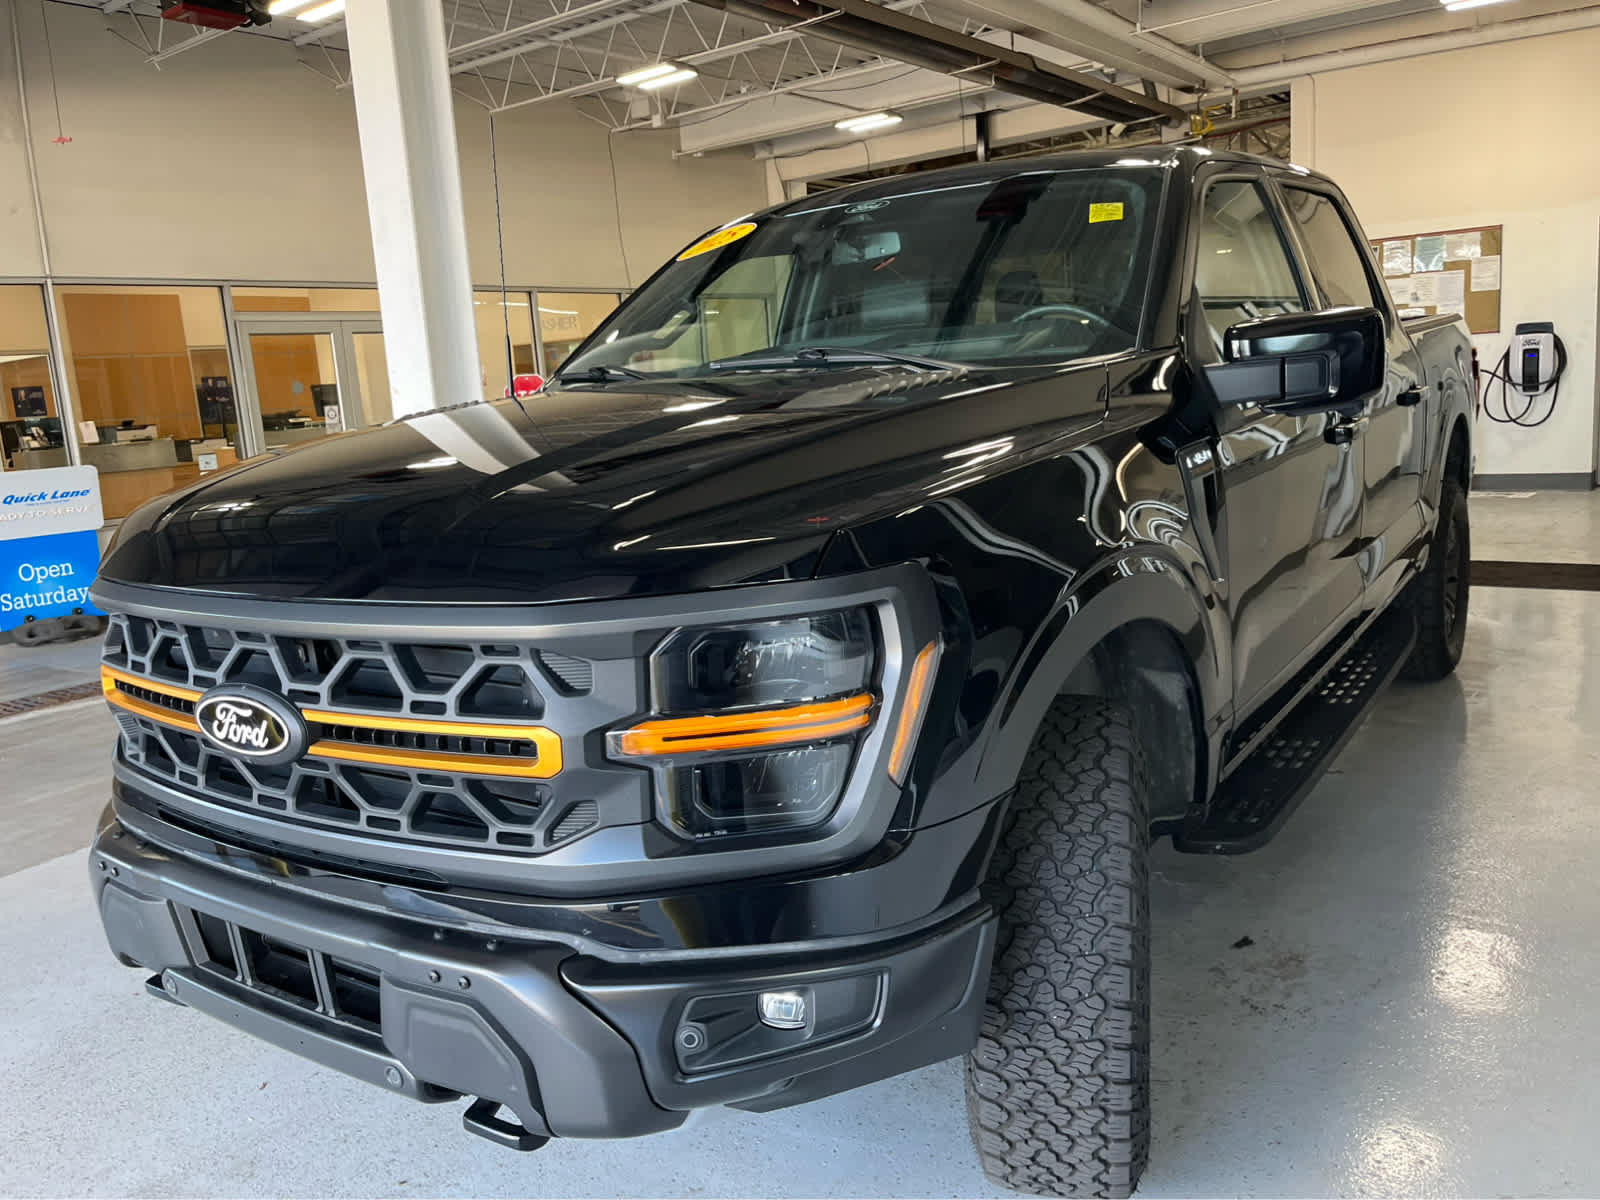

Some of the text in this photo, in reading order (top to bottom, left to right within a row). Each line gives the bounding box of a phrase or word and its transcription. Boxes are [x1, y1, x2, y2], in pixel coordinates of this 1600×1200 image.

[2, 491, 48, 505] Quick
[50, 488, 91, 500] Lane
[18, 562, 75, 584] Open
[0, 585, 89, 612] Saturday
[212, 702, 269, 748] Ford
